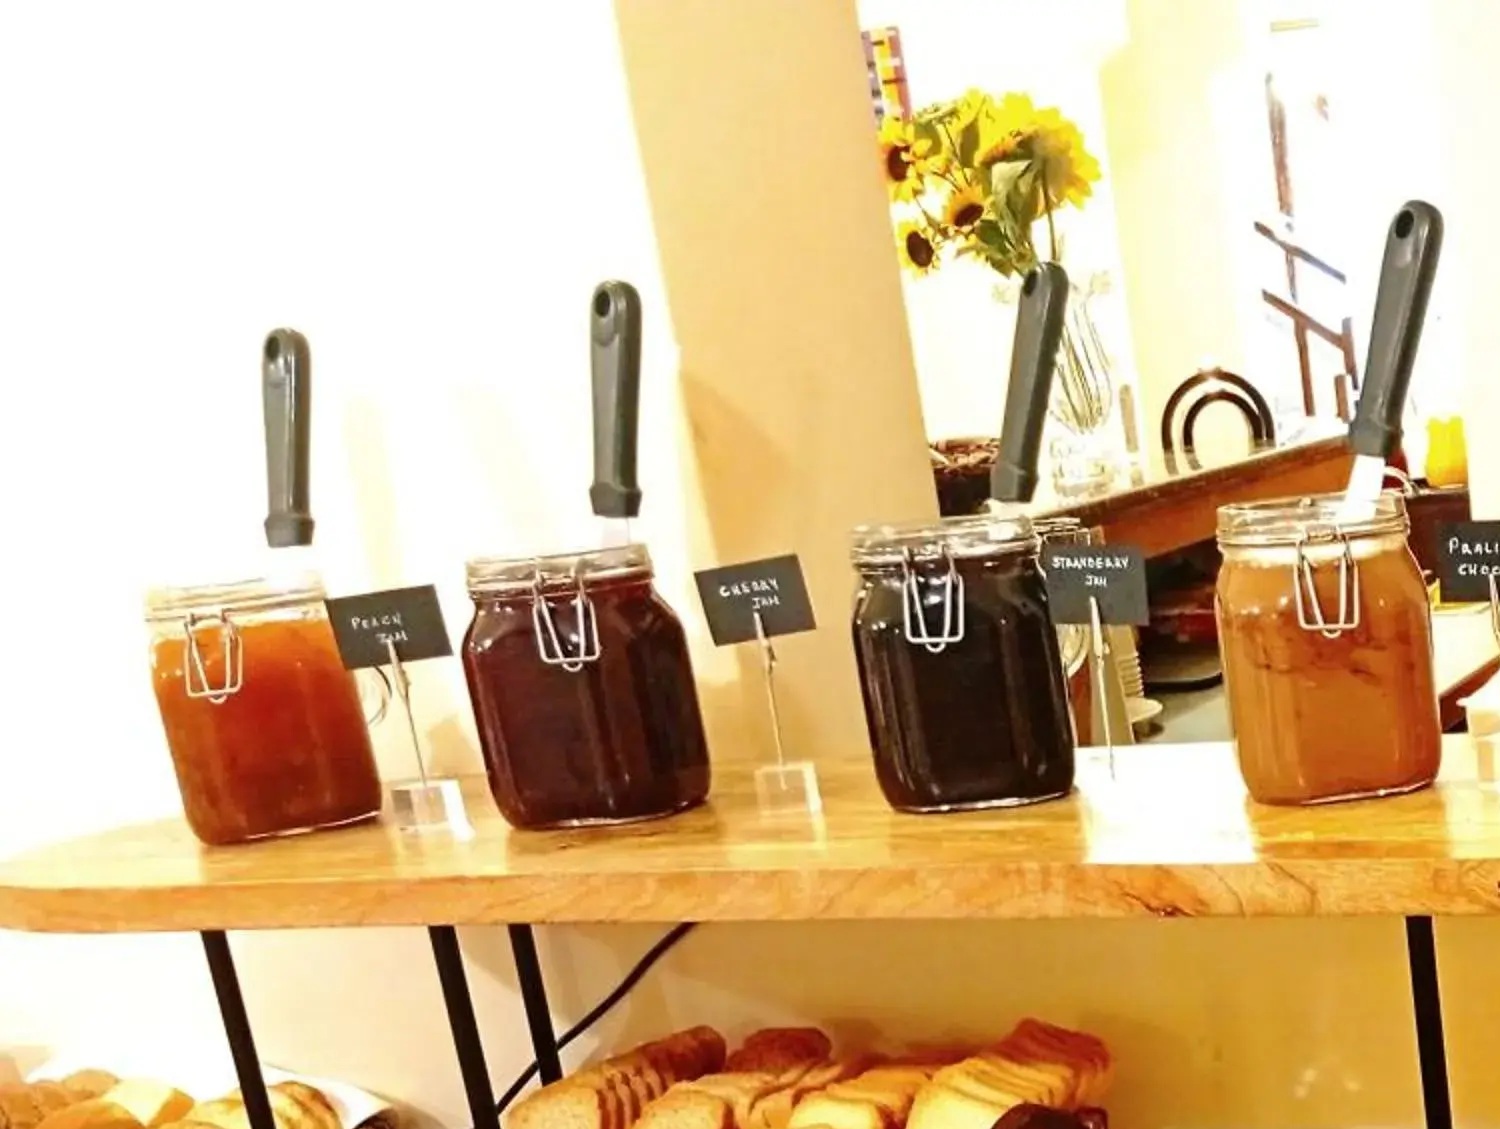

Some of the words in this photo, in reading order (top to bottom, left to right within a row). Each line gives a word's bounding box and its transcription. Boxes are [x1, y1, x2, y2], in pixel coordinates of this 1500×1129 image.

[719, 577, 780, 598] CHERRY
[1084, 574, 1108, 588] JAM
[751, 595, 781, 610] JAM
[351, 611, 402, 631] PEACH
